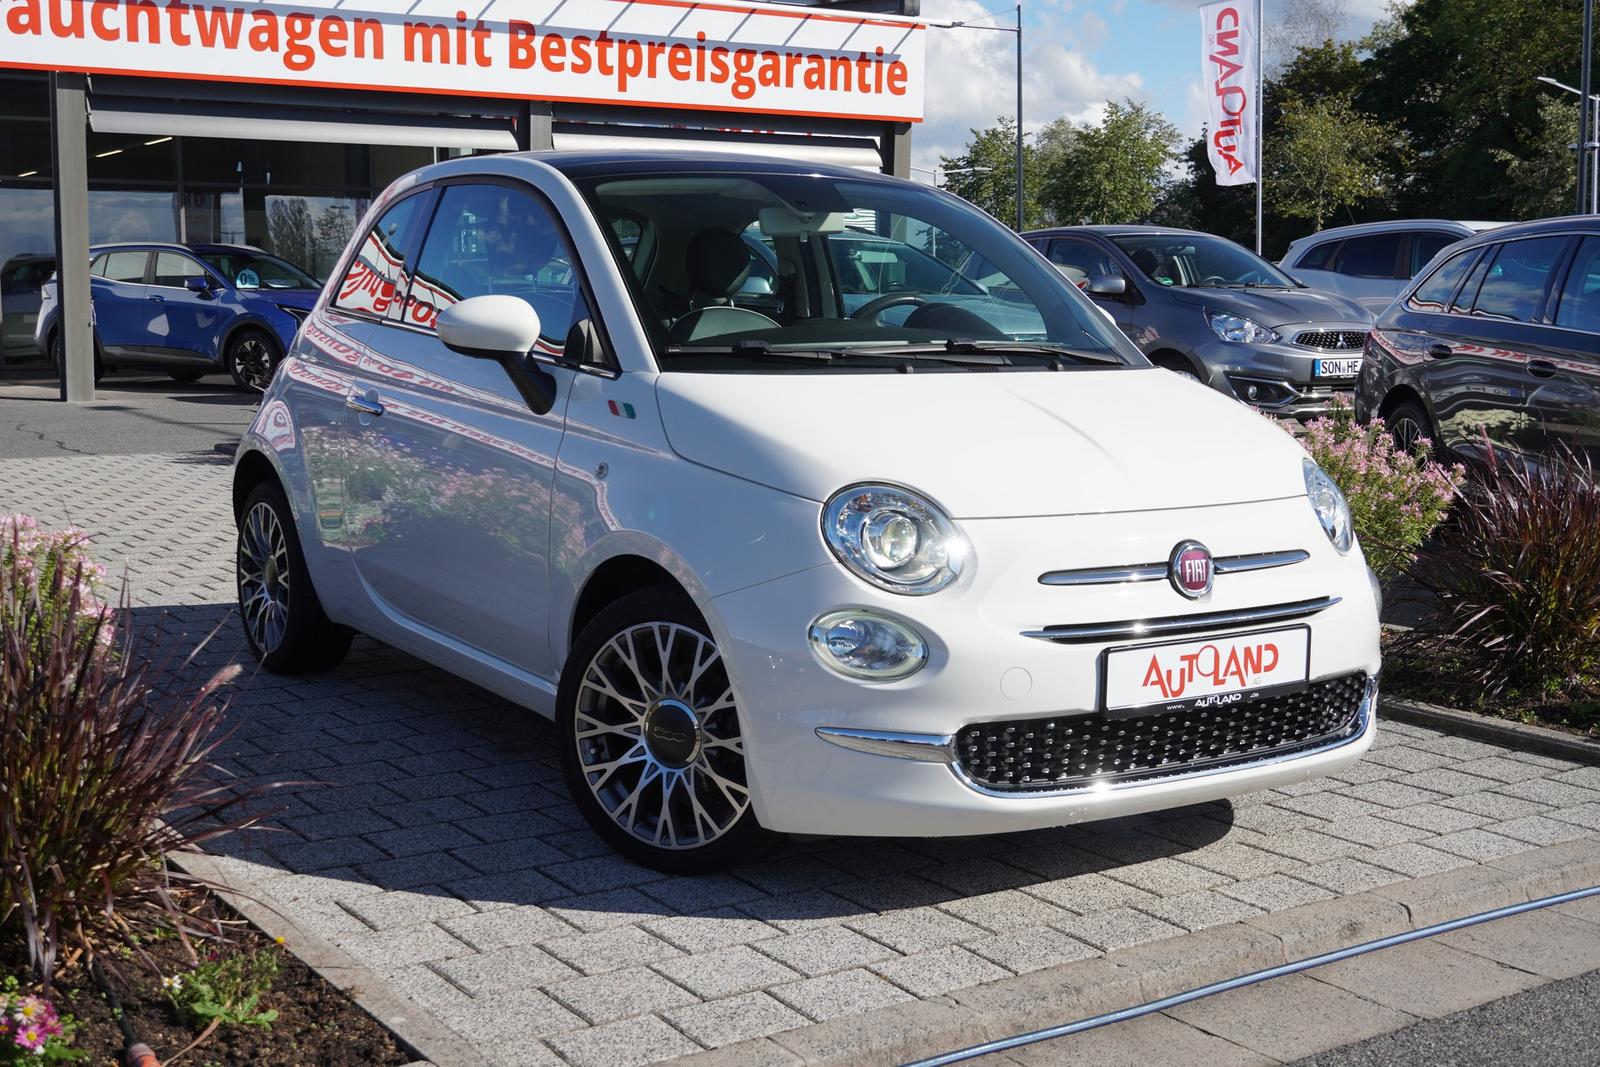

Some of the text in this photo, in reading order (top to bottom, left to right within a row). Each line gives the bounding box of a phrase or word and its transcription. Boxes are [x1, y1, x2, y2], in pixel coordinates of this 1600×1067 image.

[404, 11, 492, 67] mit
[508, 19, 908, 99] Bestpreisgarantie
[1321, 360, 1359, 374] SON HE
[1185, 559, 1207, 583] FIAT
